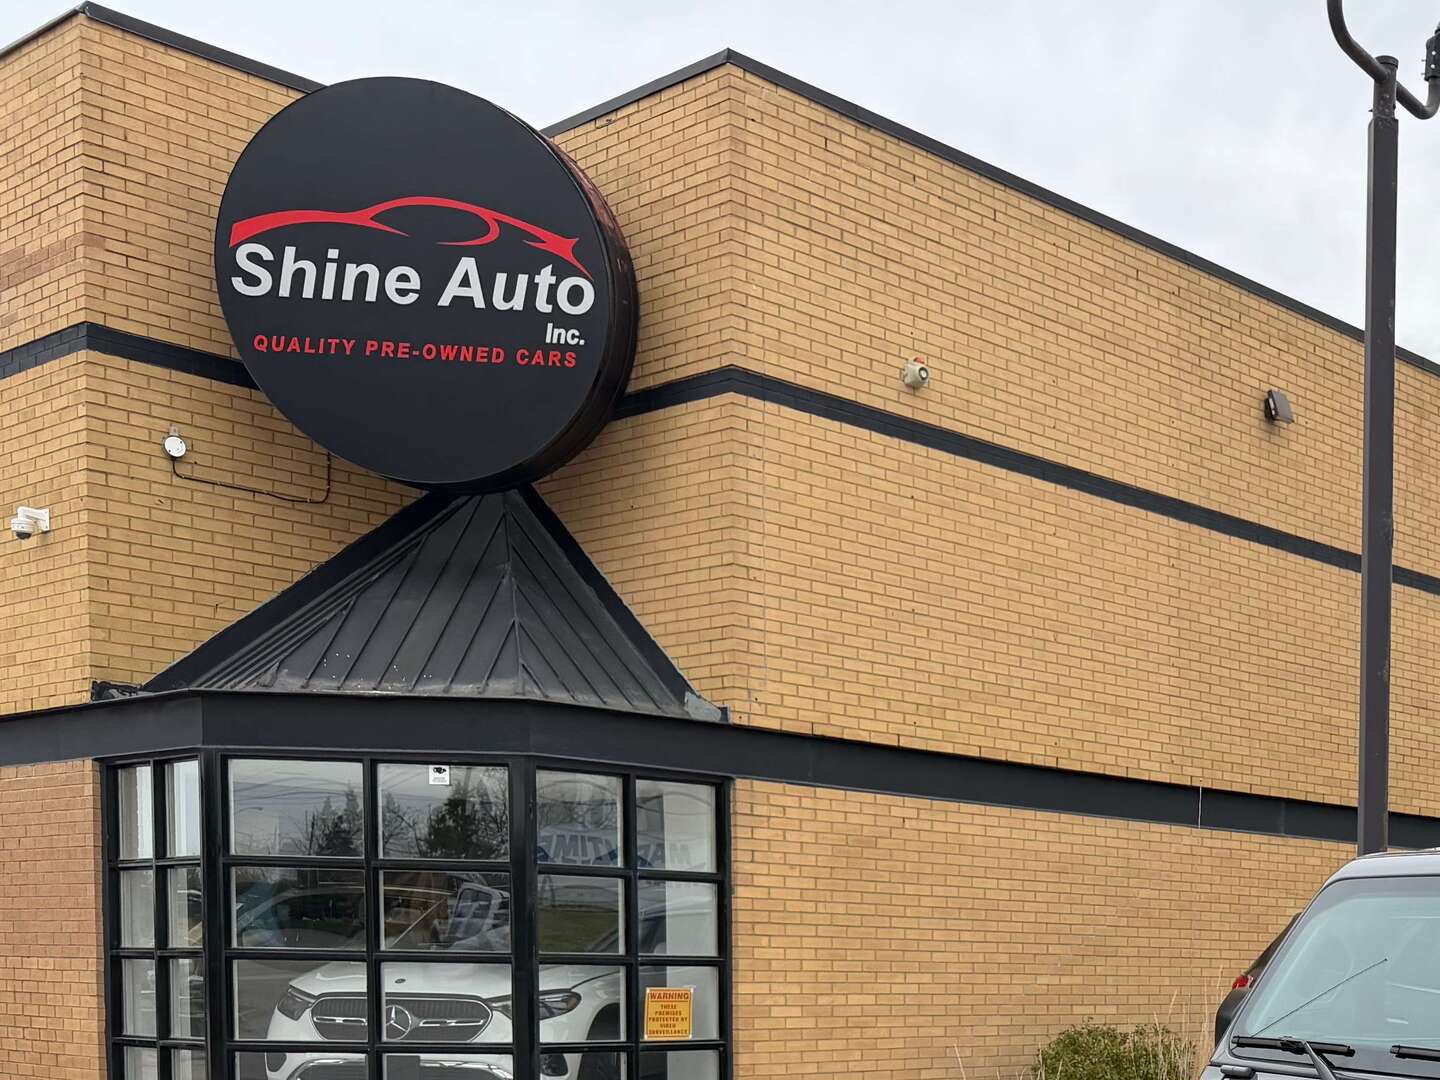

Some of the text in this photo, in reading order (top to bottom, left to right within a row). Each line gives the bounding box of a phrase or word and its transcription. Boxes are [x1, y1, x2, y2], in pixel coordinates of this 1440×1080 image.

[231, 242, 595, 316] Shine Auto
[544, 322, 586, 347] Inc.
[252, 335, 577, 368] QUALITY PRE-OWNED CARS
